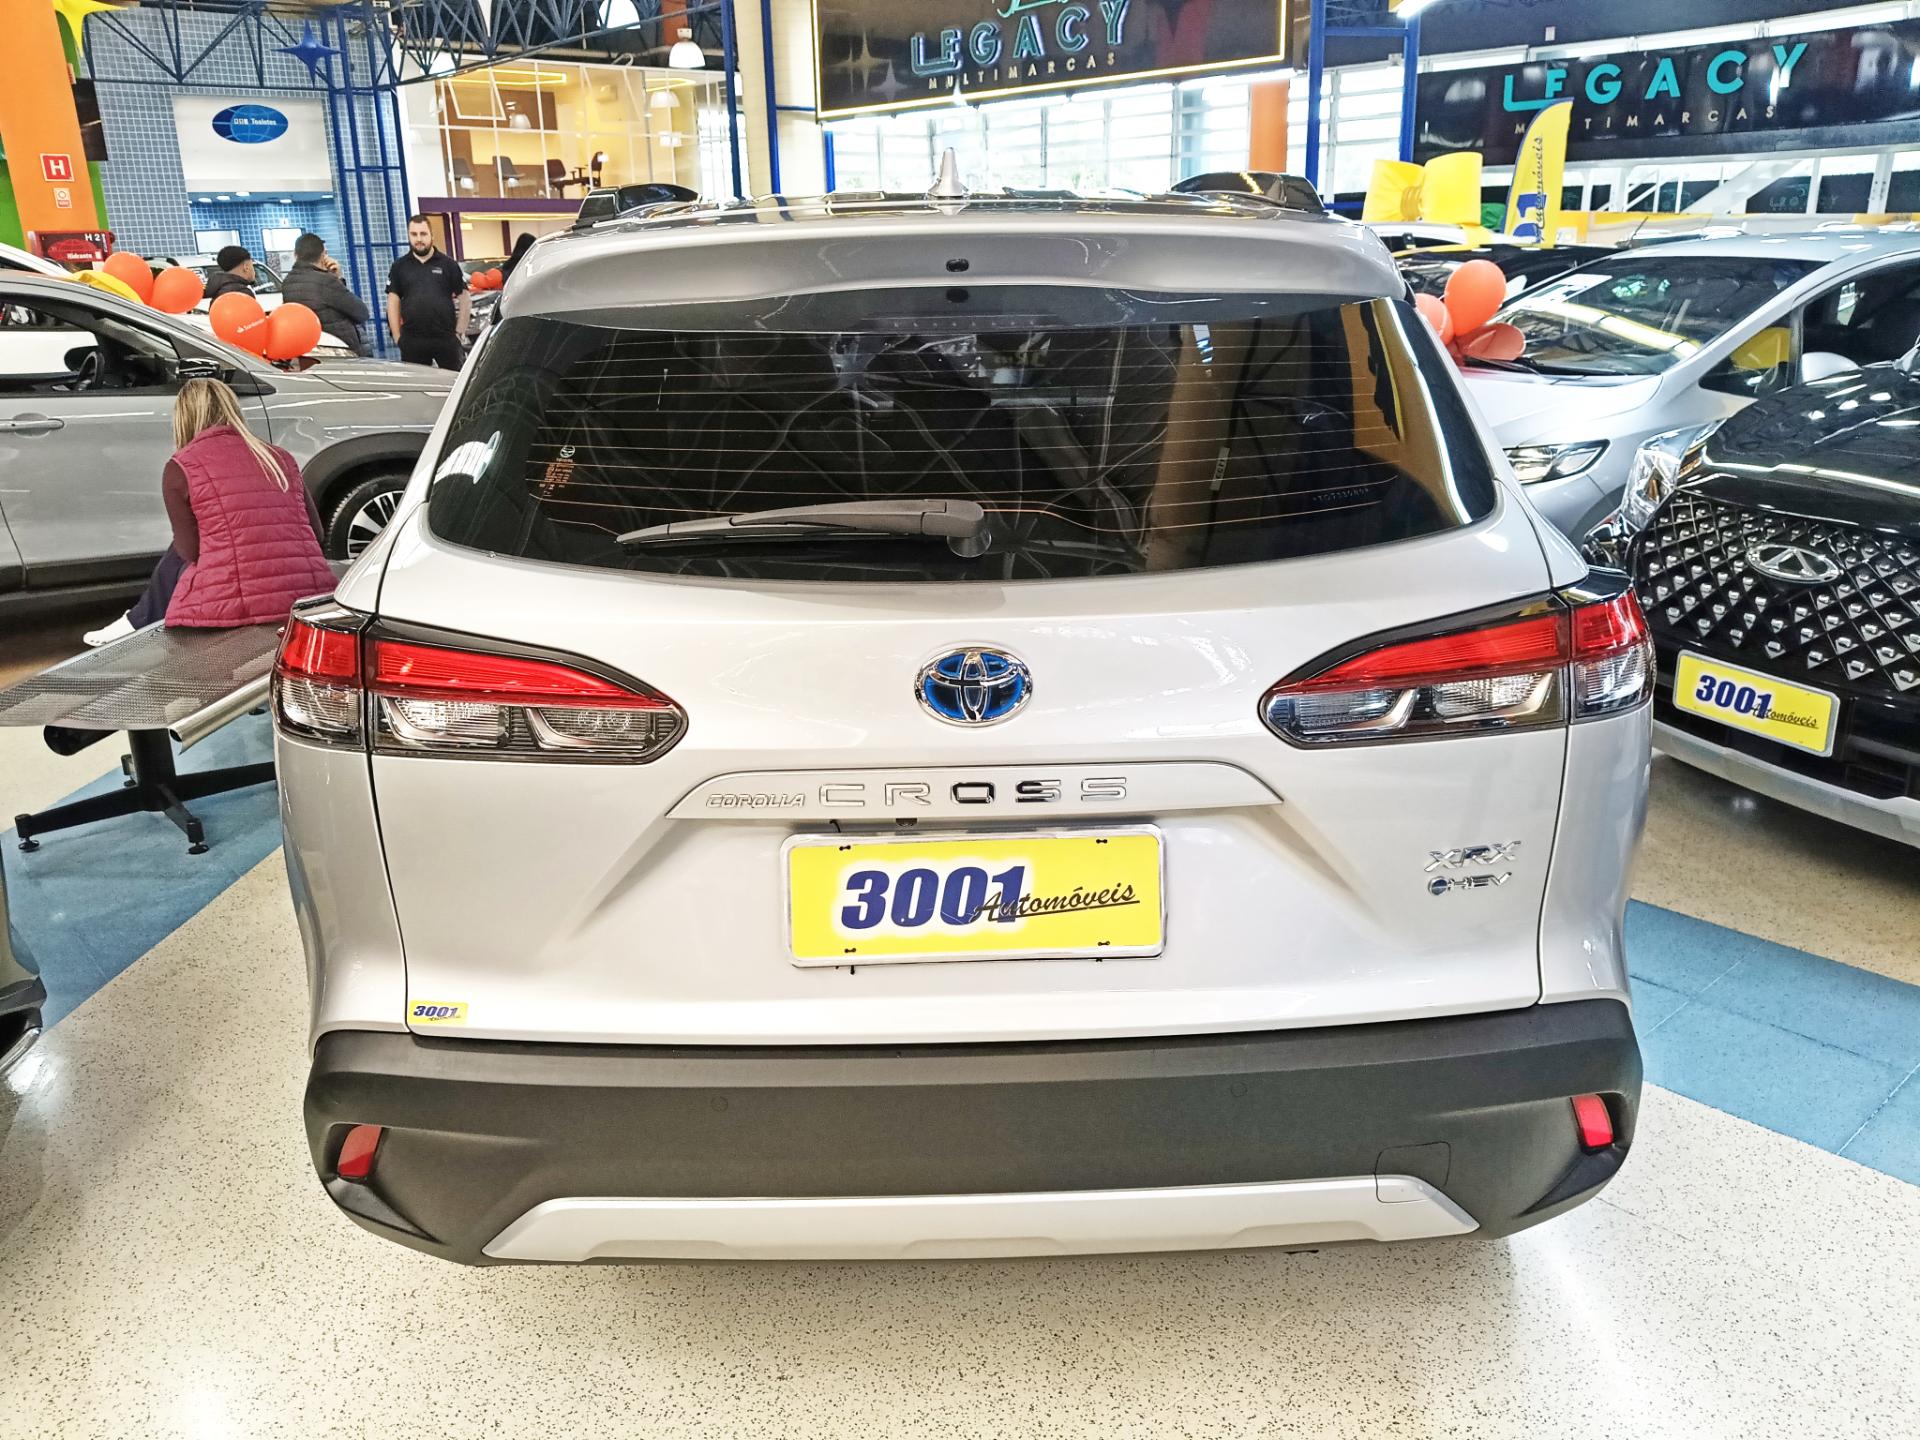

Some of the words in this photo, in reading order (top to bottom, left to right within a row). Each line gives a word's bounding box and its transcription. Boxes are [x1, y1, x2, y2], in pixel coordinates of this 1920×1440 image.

[911, 0, 1129, 76] LEGACY
[928, 52, 1116, 90] MULTIMARCAS
[1503, 43, 1808, 112] LEGACY
[1514, 105, 1778, 135] MTIMARCAS
[49, 159, 66, 176] H
[1695, 674, 1772, 720] 3001
[706, 793, 805, 809] COROLLA
[819, 777, 1127, 808] CROSS
[1424, 840, 1521, 872] XRX
[841, 865, 1025, 930] 3001
[969, 882, 1140, 923] Automóveis
[1447, 872, 1512, 891] HEV
[413, 1005, 458, 1018] 3001
